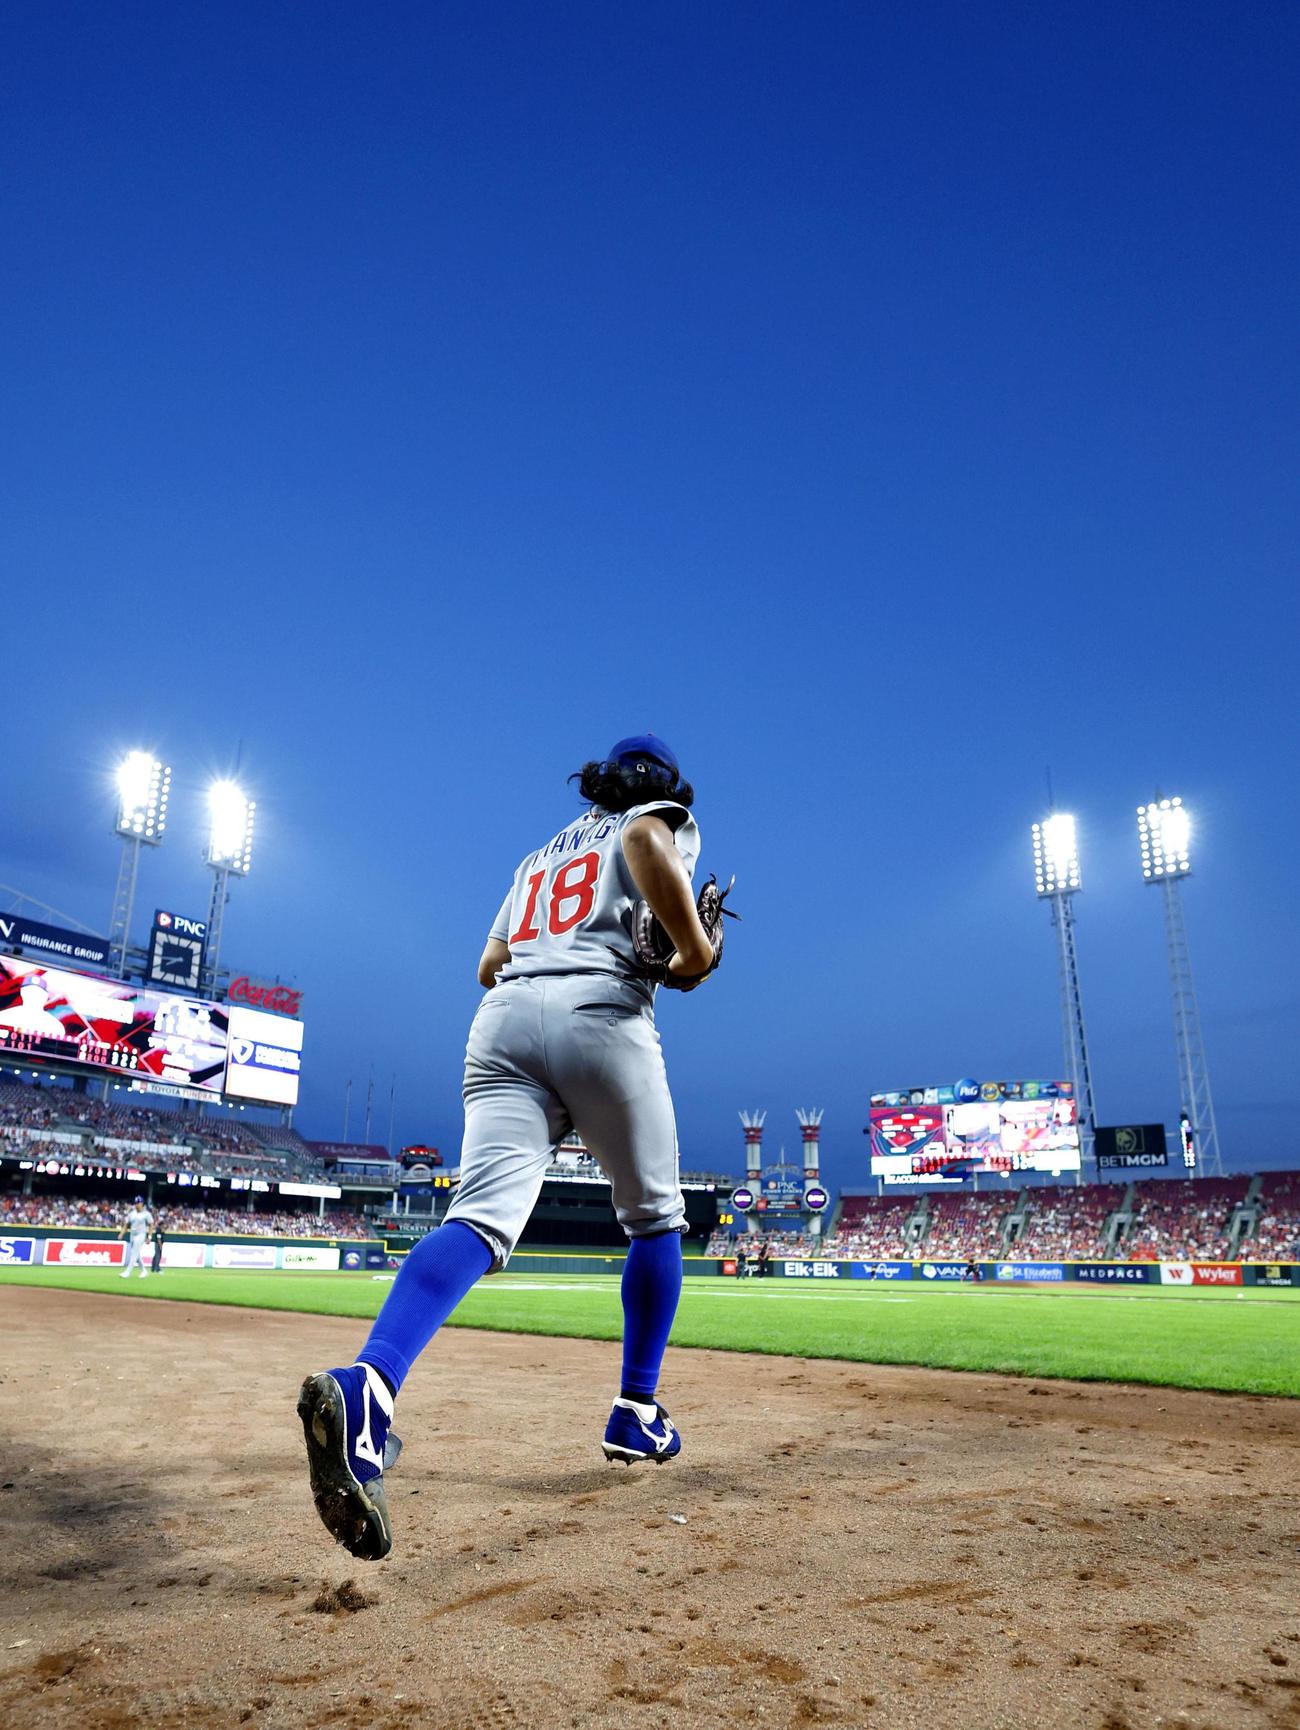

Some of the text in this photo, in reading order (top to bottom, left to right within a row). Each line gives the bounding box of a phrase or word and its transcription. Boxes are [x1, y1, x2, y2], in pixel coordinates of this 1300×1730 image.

[509, 851, 601, 945] 18
[174, 916, 206, 938] PNC
[21, 933, 104, 961] INSURANCE GROUP
[151, 1085, 180, 1095] TOYOTA
[1100, 1154, 1165, 1167] BETMGM
[777, 1181, 798, 1190] PNC
[1079, 1268, 1143, 1279] MEDPACE
[1197, 1267, 1237, 1282] Wyler
